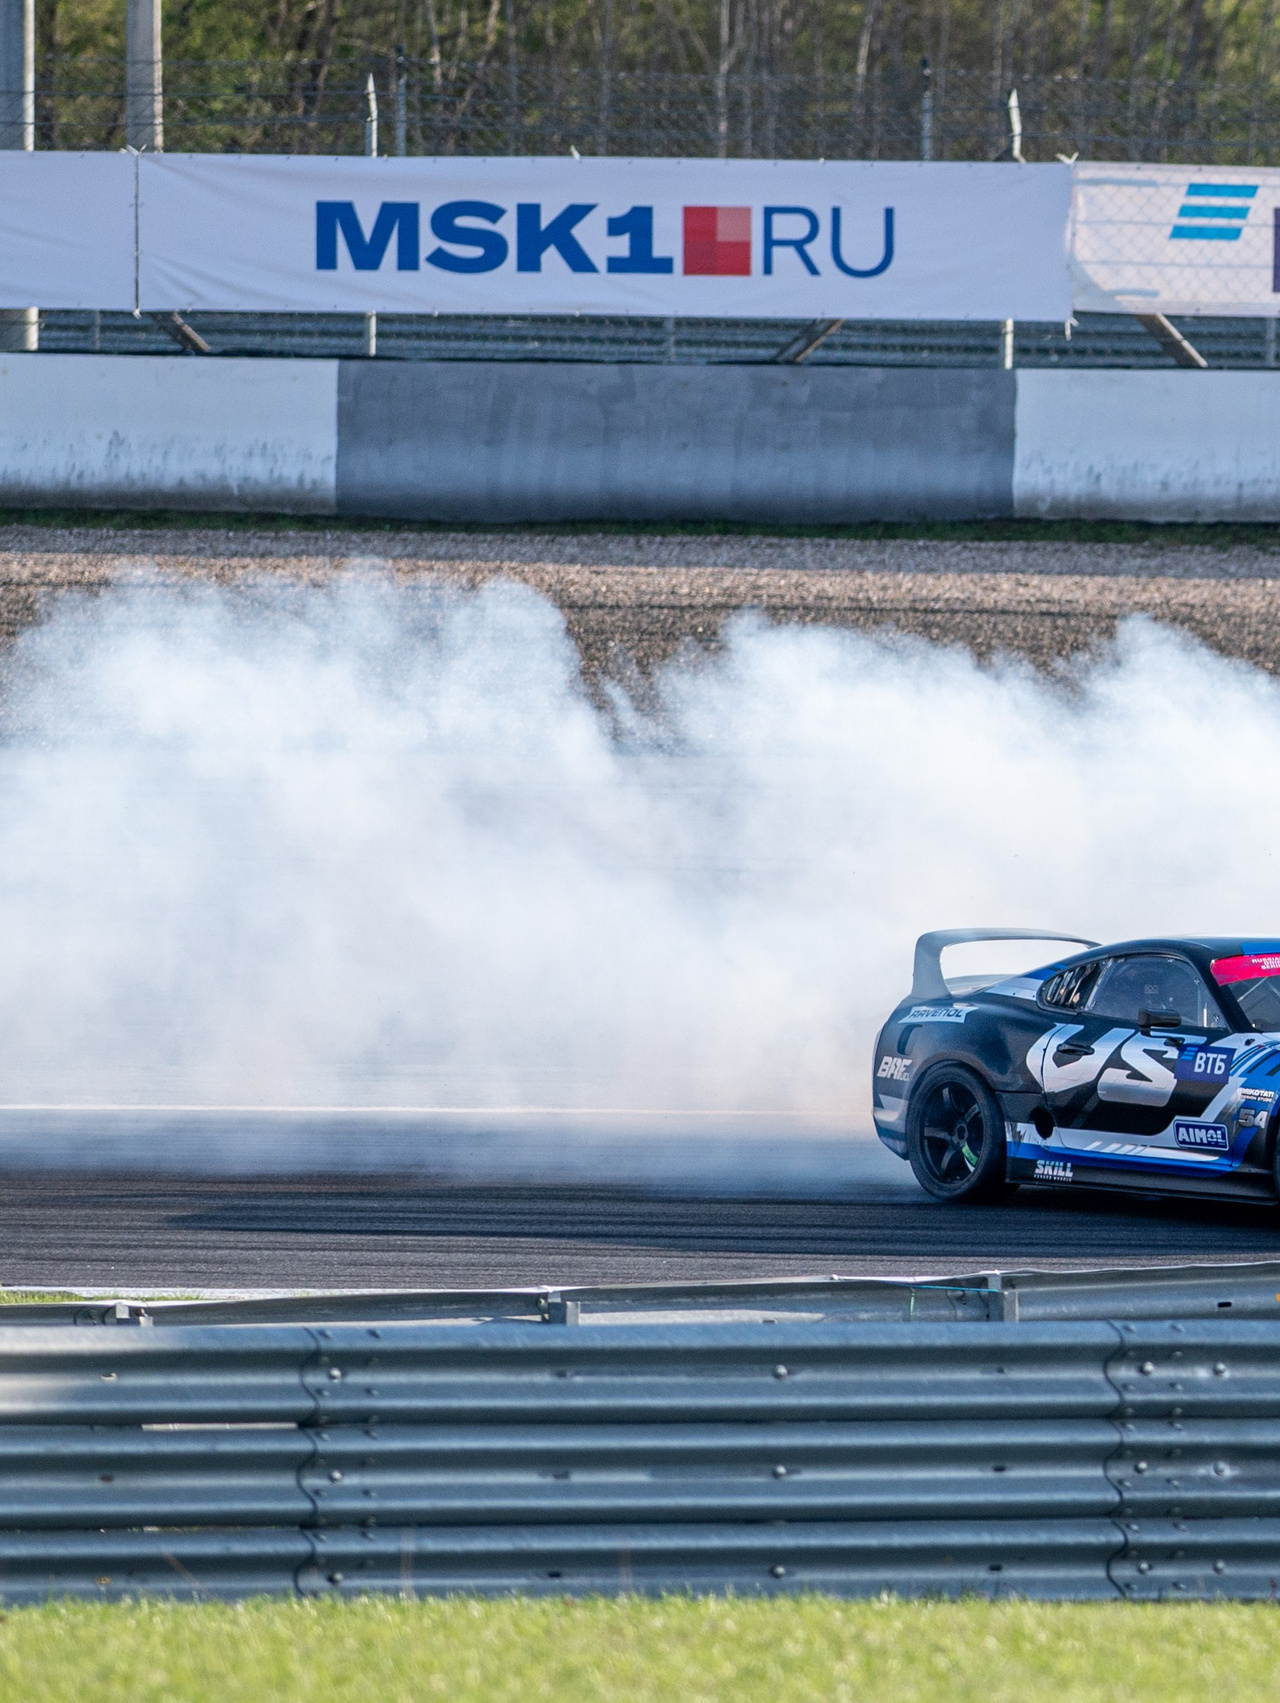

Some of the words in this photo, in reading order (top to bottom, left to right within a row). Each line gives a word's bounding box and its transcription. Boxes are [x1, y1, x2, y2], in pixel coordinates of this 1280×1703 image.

[909, 1008, 964, 1019] RAVENOL
[1193, 1051, 1228, 1075] ВТБ
[1238, 1108, 1268, 1129] 54
[1178, 1127, 1226, 1144] AIMOL
[1035, 1159, 1074, 1178] SKILL
